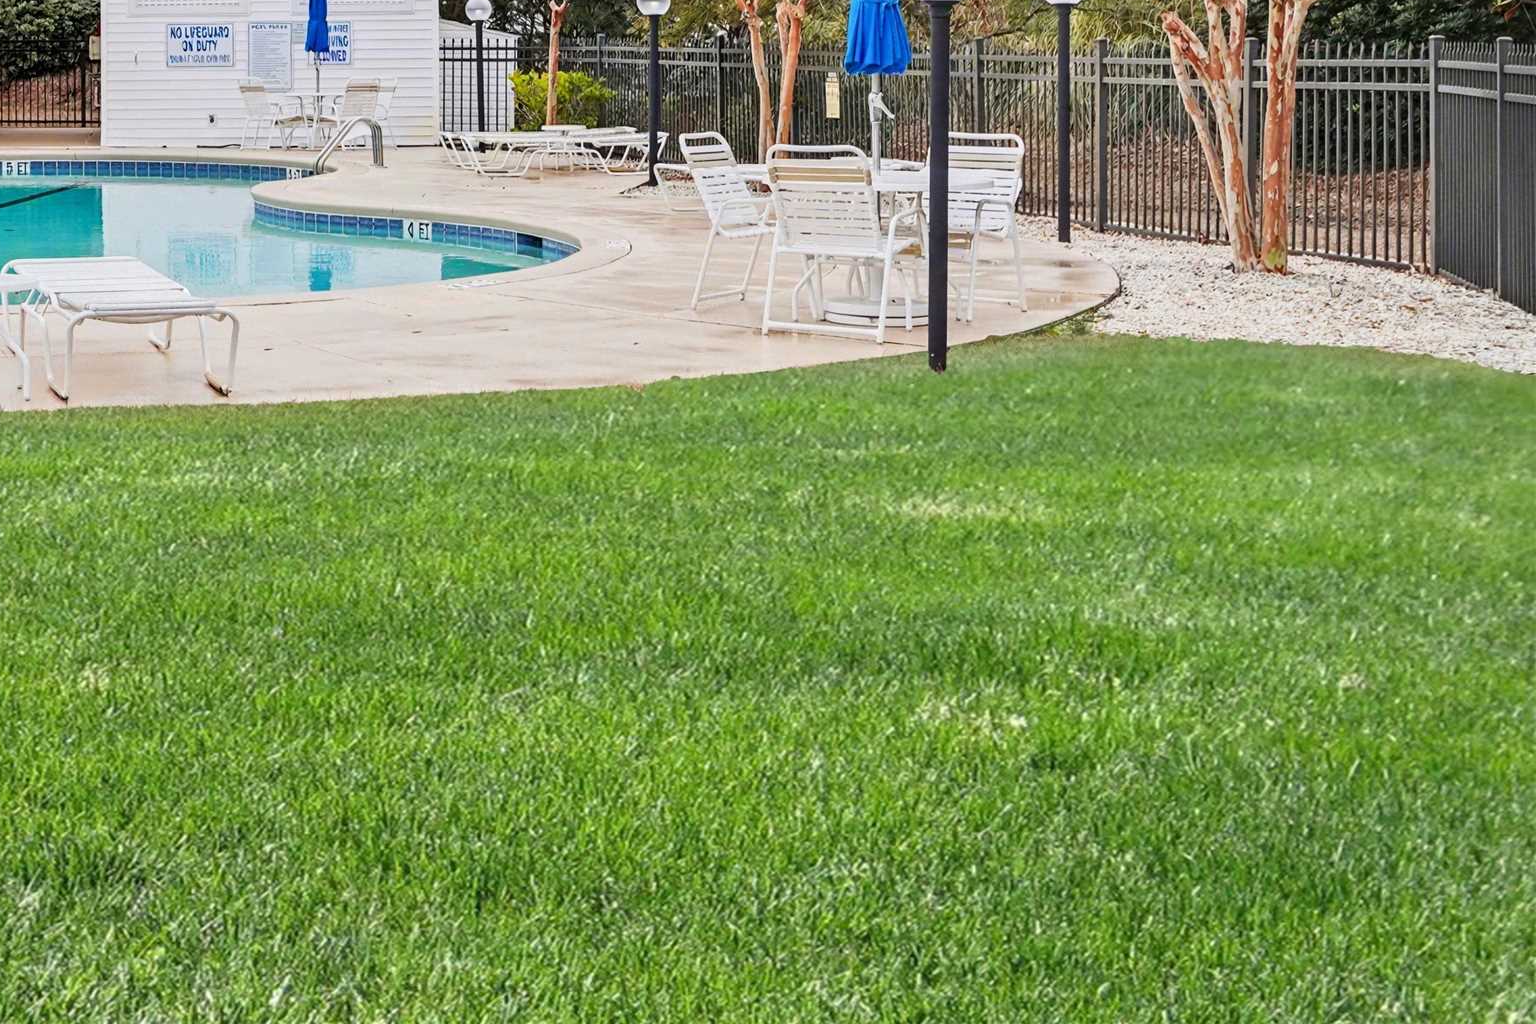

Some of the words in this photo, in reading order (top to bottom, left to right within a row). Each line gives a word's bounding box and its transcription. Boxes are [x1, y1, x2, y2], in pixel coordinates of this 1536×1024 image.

[170, 26, 182, 39] NO
[184, 26, 229, 38] LIFEGUARD
[182, 40, 193, 52] ON
[196, 40, 218, 52] DUTY
